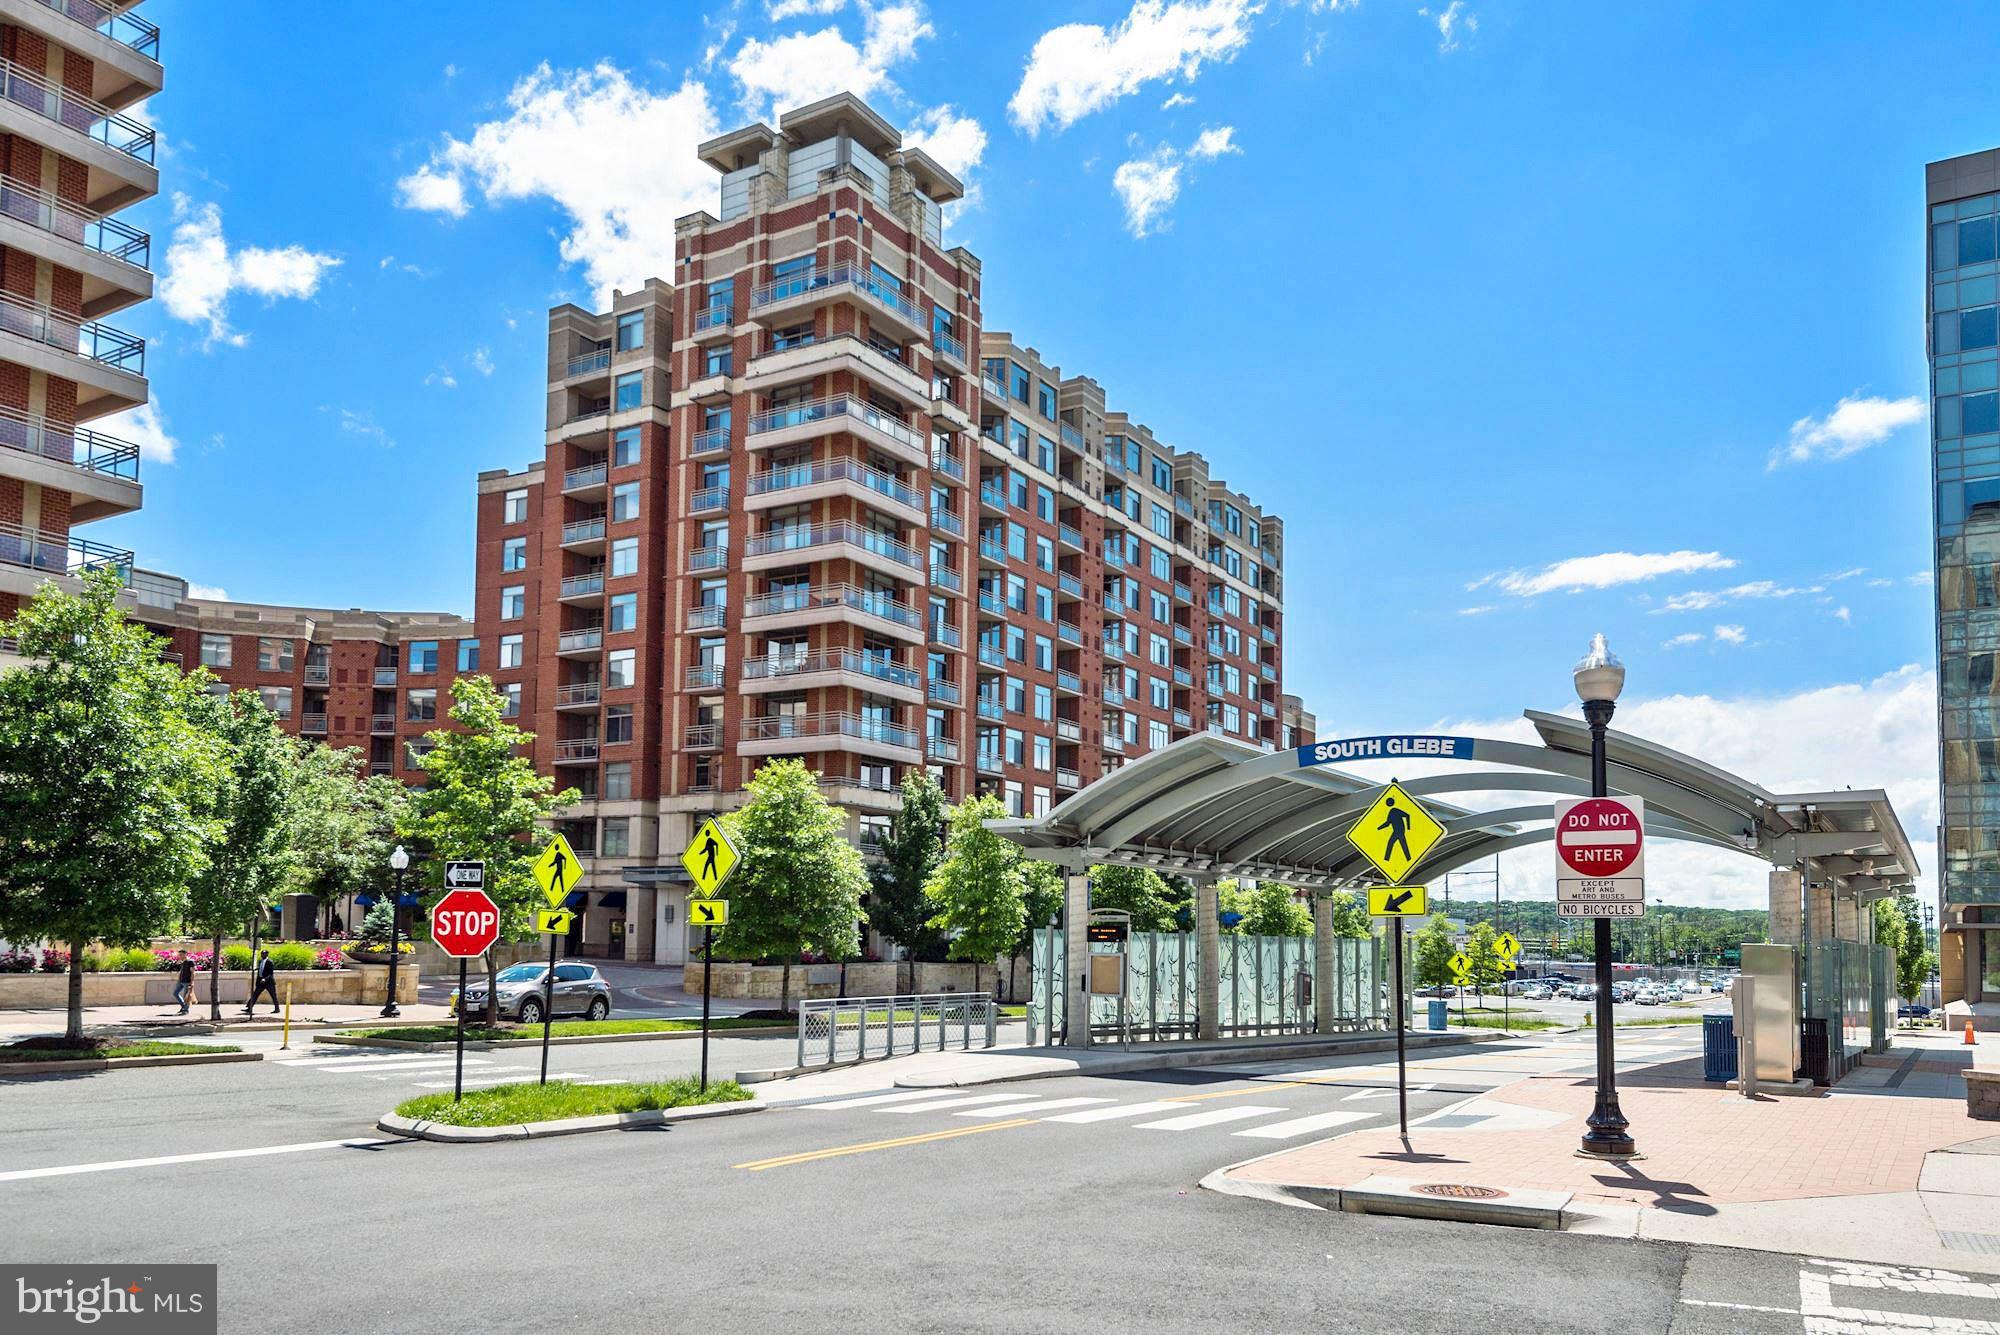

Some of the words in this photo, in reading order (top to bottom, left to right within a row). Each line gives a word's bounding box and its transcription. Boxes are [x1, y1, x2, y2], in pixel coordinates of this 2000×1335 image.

[1314, 740, 1381, 761] SOUTH
[1386, 738, 1455, 755] GLEBE
[1569, 815, 1589, 827] DO
[1599, 813, 1629, 826] NOT
[1574, 849, 1623, 861] ENTER
[456, 870, 467, 880] ONE
[469, 870, 480, 880] WAY
[1563, 905, 1577, 914] NO
[1583, 905, 1635, 915] BICYCLES
[437, 911, 495, 936] STOP
